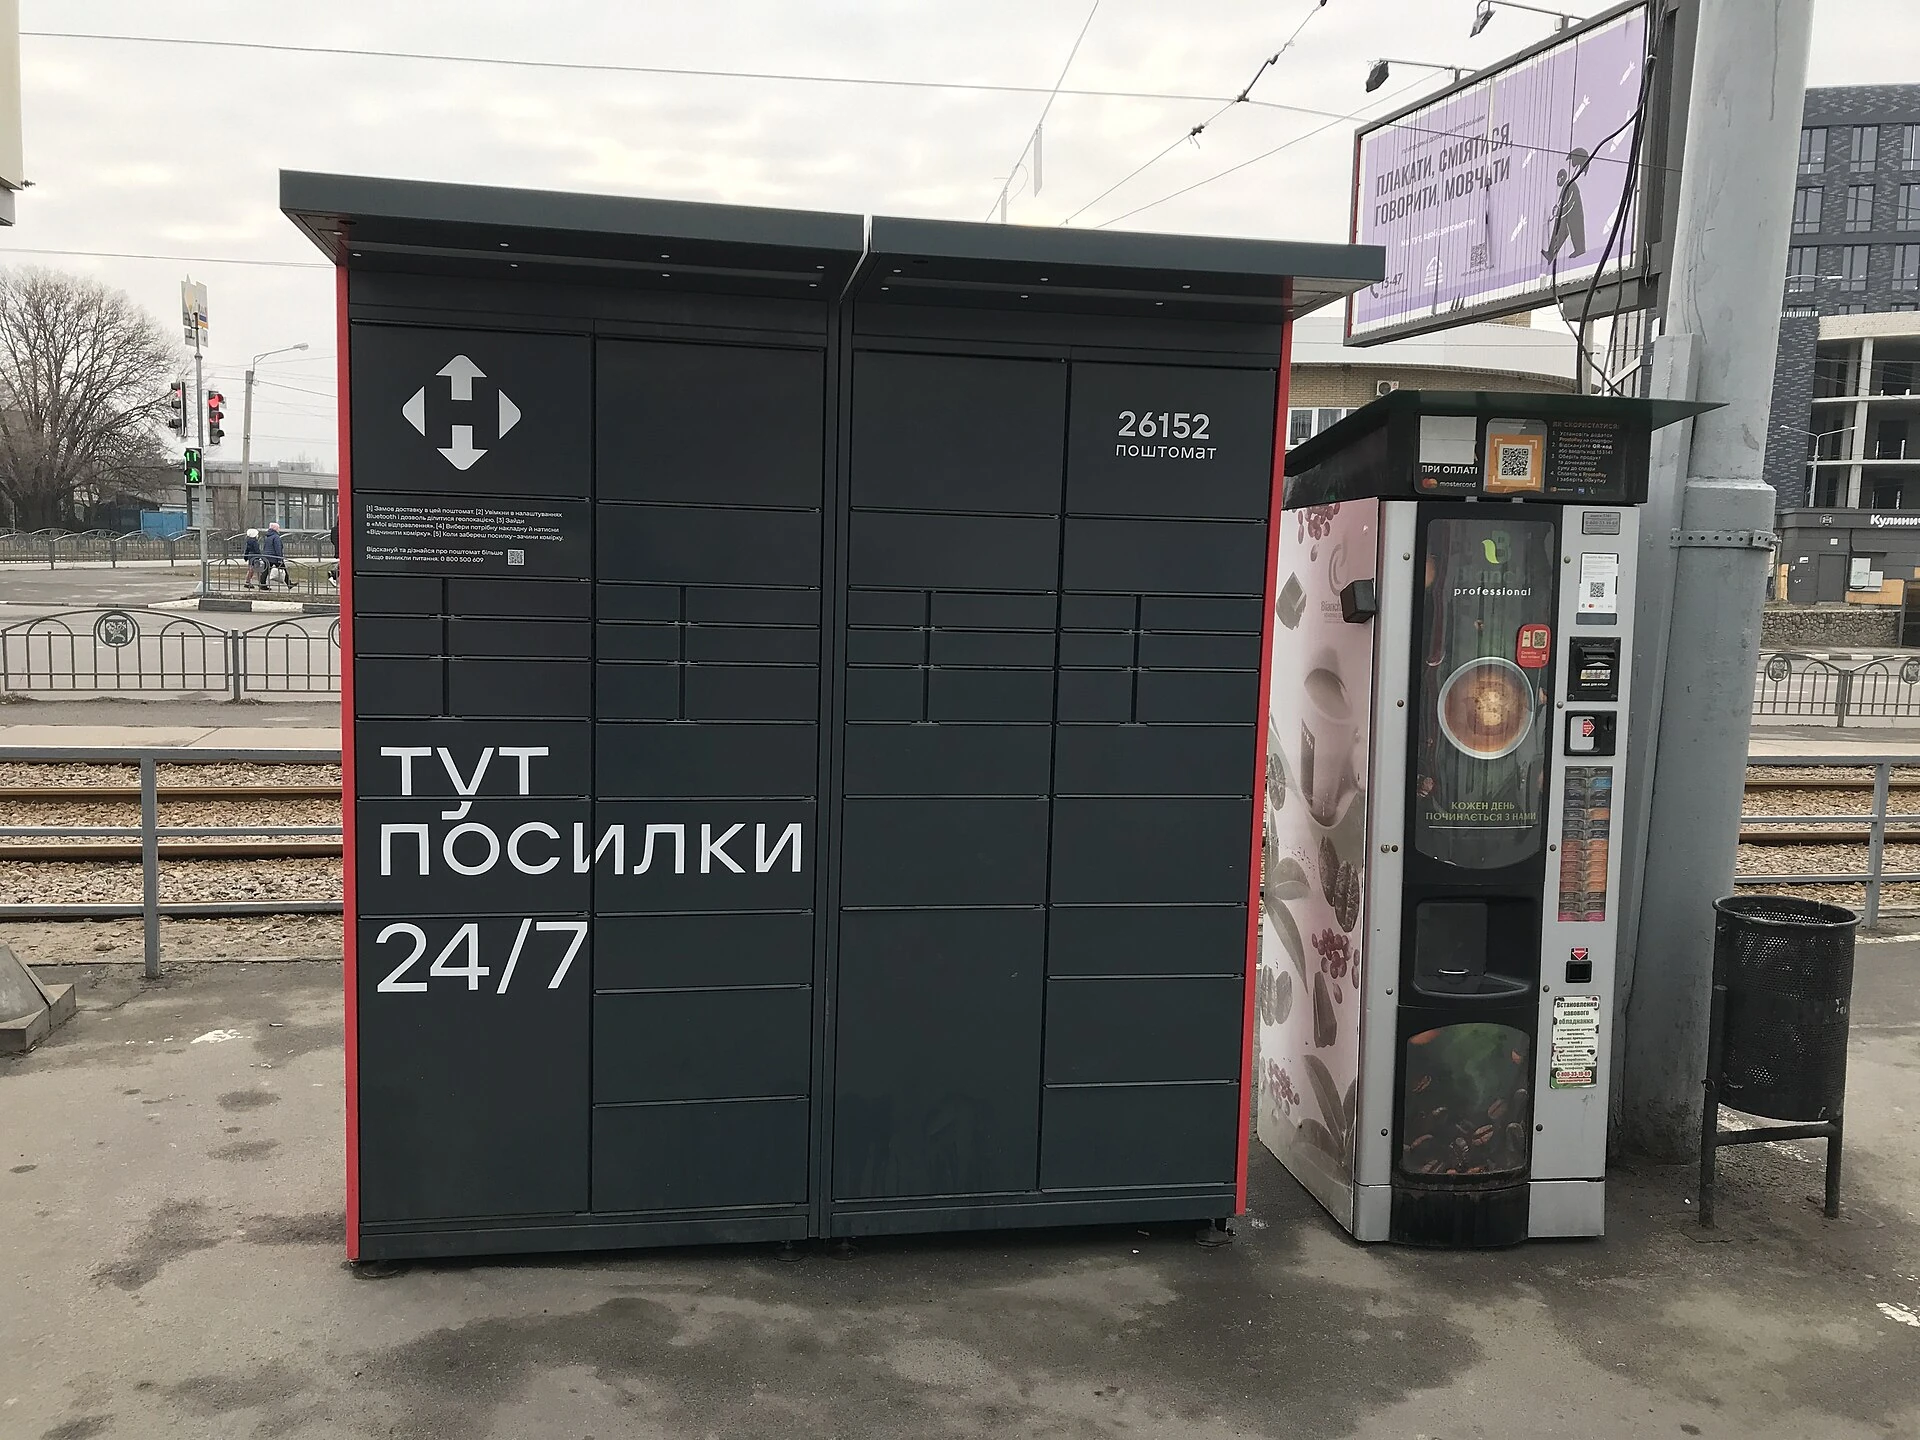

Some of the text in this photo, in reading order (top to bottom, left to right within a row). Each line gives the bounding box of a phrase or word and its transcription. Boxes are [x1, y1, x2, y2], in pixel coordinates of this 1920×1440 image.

[1376, 122, 1513, 197] ПЛАКАТИ, СМІЯТИСЯ,
[1374, 156, 1510, 226] ГОВОРИТИ, МОВЧАТИ
[1118, 410, 1210, 440] 26152
[1116, 444, 1216, 460] поштомат
[1443, 466, 1478, 474] ОПЛАТІ
[1454, 586, 1531, 596] professional
[380, 746, 549, 820] тут
[1426, 812, 1502, 821] ПОЧИНАЄТЬСЯ
[1451, 802, 1515, 810] КОЖЕН ДЕНЬ
[380, 822, 802, 876] посилки
[375, 918, 589, 994] 24/7
